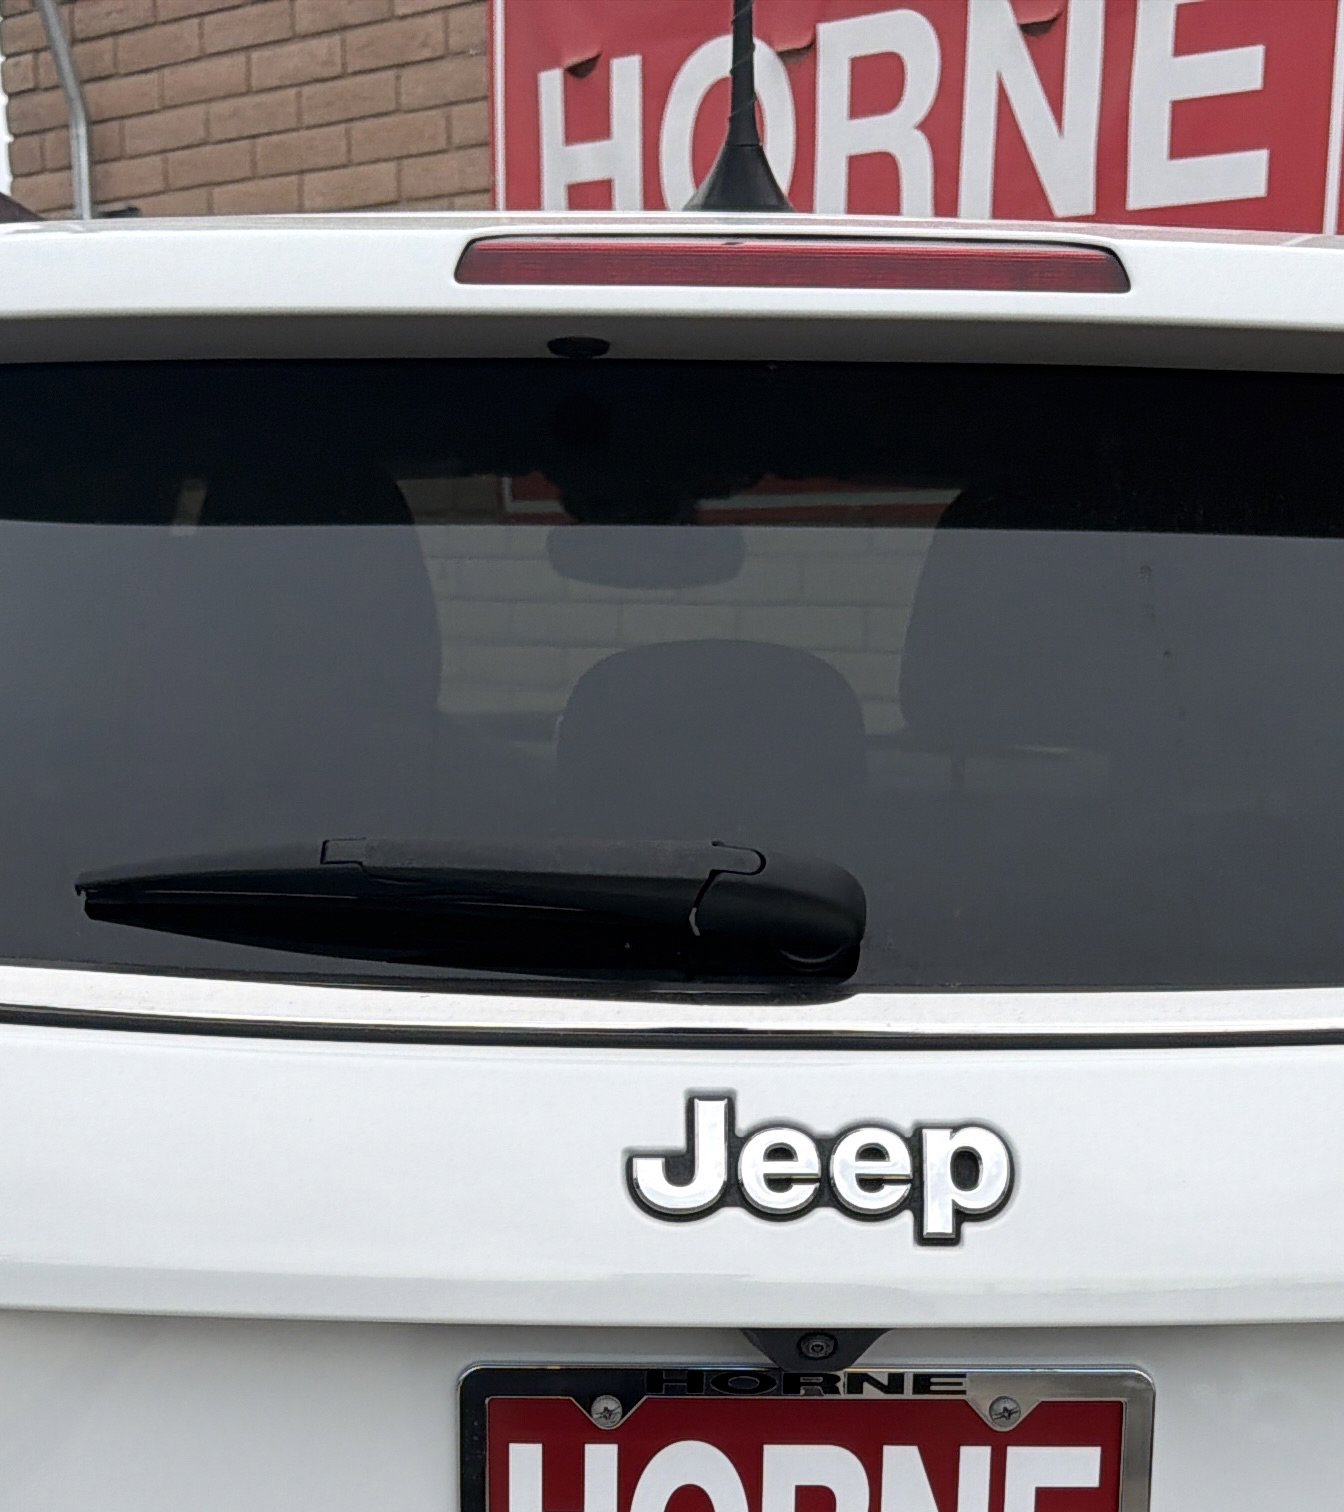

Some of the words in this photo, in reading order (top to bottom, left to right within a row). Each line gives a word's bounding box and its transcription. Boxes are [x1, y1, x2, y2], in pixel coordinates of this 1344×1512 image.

[537, 0, 1270, 218] HORNE
[627, 1093, 1016, 1244] Jeep
[646, 1371, 968, 1396] HORNE
